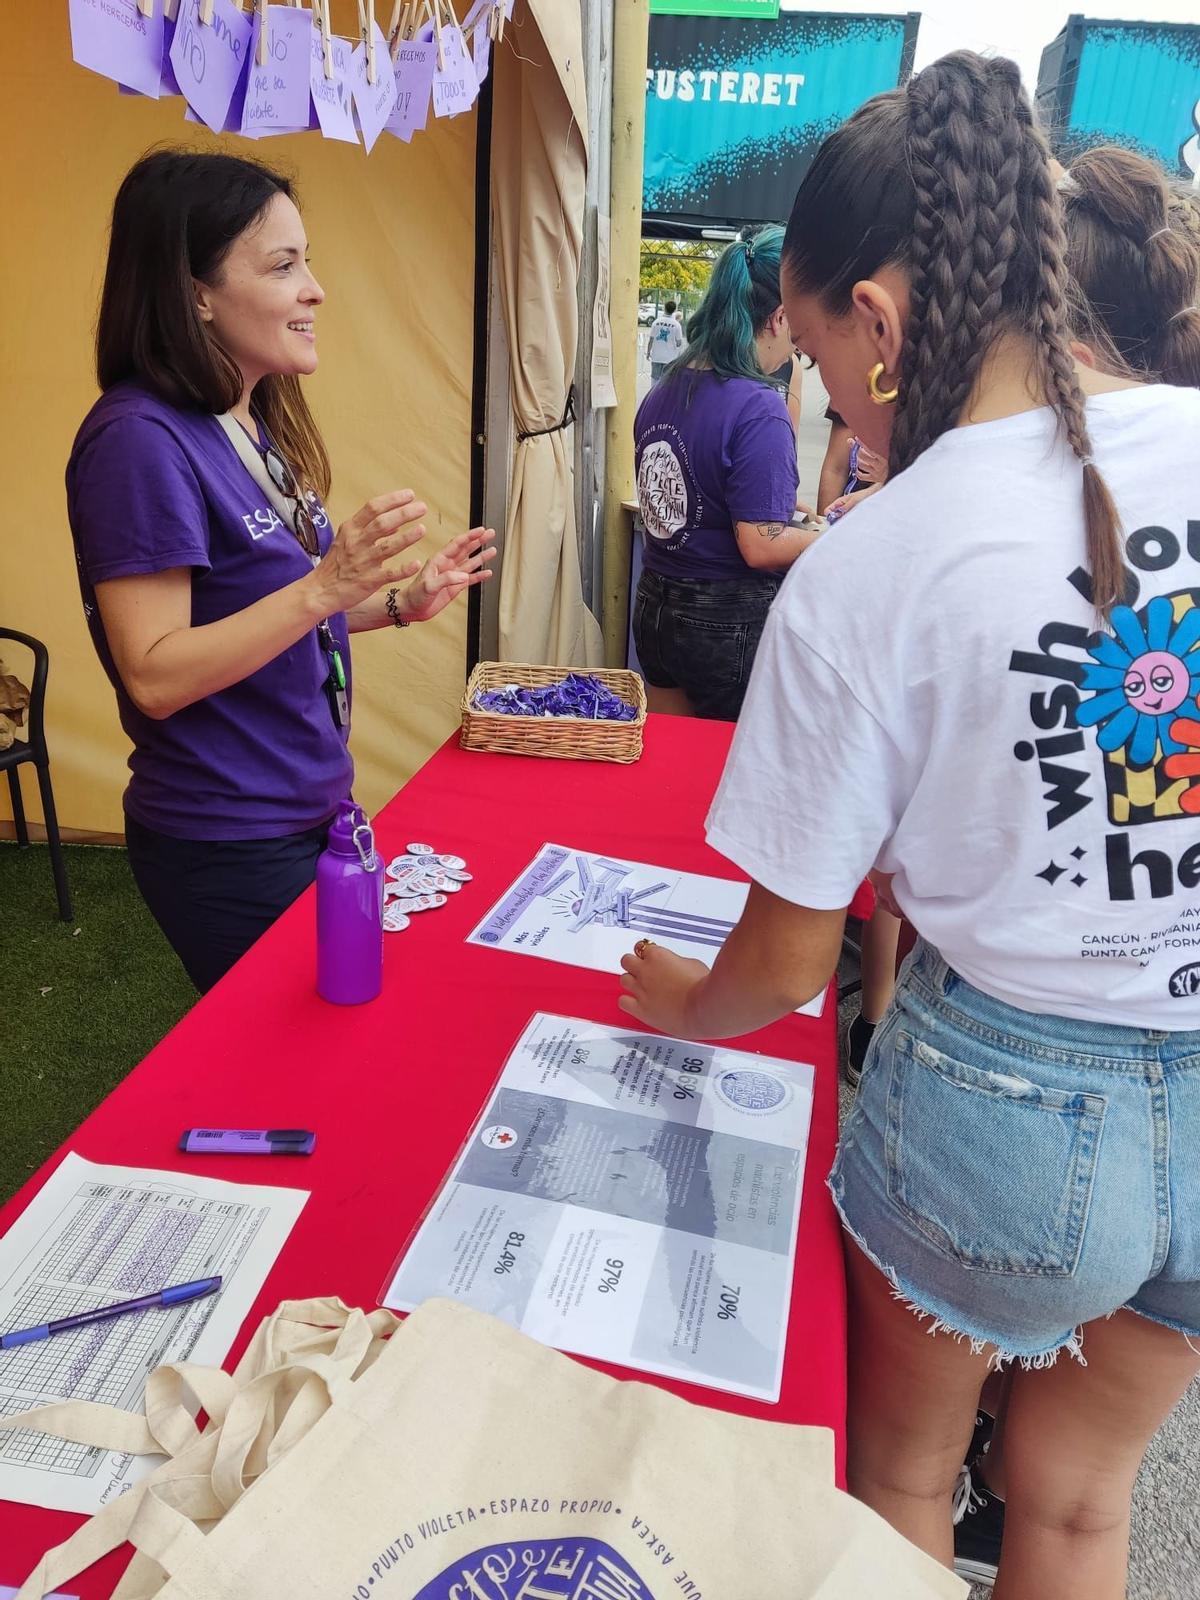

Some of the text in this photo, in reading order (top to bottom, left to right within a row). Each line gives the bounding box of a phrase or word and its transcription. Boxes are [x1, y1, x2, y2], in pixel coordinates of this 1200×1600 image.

[1009, 620, 1095, 832] wish
[514, 929, 530, 945] Más
[531, 926, 550, 947] visibles
[1081, 932, 1140, 944] CANCÚN
[1081, 949, 1127, 958] PUNTA
[570, 1047, 591, 1066] 8%
[637, 1084, 650, 1105] sexual
[650, 1094, 659, 1107] han
[723, 1202, 738, 1222] ocio
[746, 1206, 759, 1220] en
[765, 1181, 782, 1227] violencias
[492, 1230, 526, 1276] 81.4%
[596, 1257, 624, 1295] 97%
[716, 1282, 741, 1322] 70%
[372, 1533, 414, 1578] PUNTO
[418, 1507, 477, 1540] VIOLETA
[490, 1498, 549, 1514] ESPAZO
[560, 1499, 613, 1513] PROPIO
[631, 1515, 675, 1566] ASKEA
